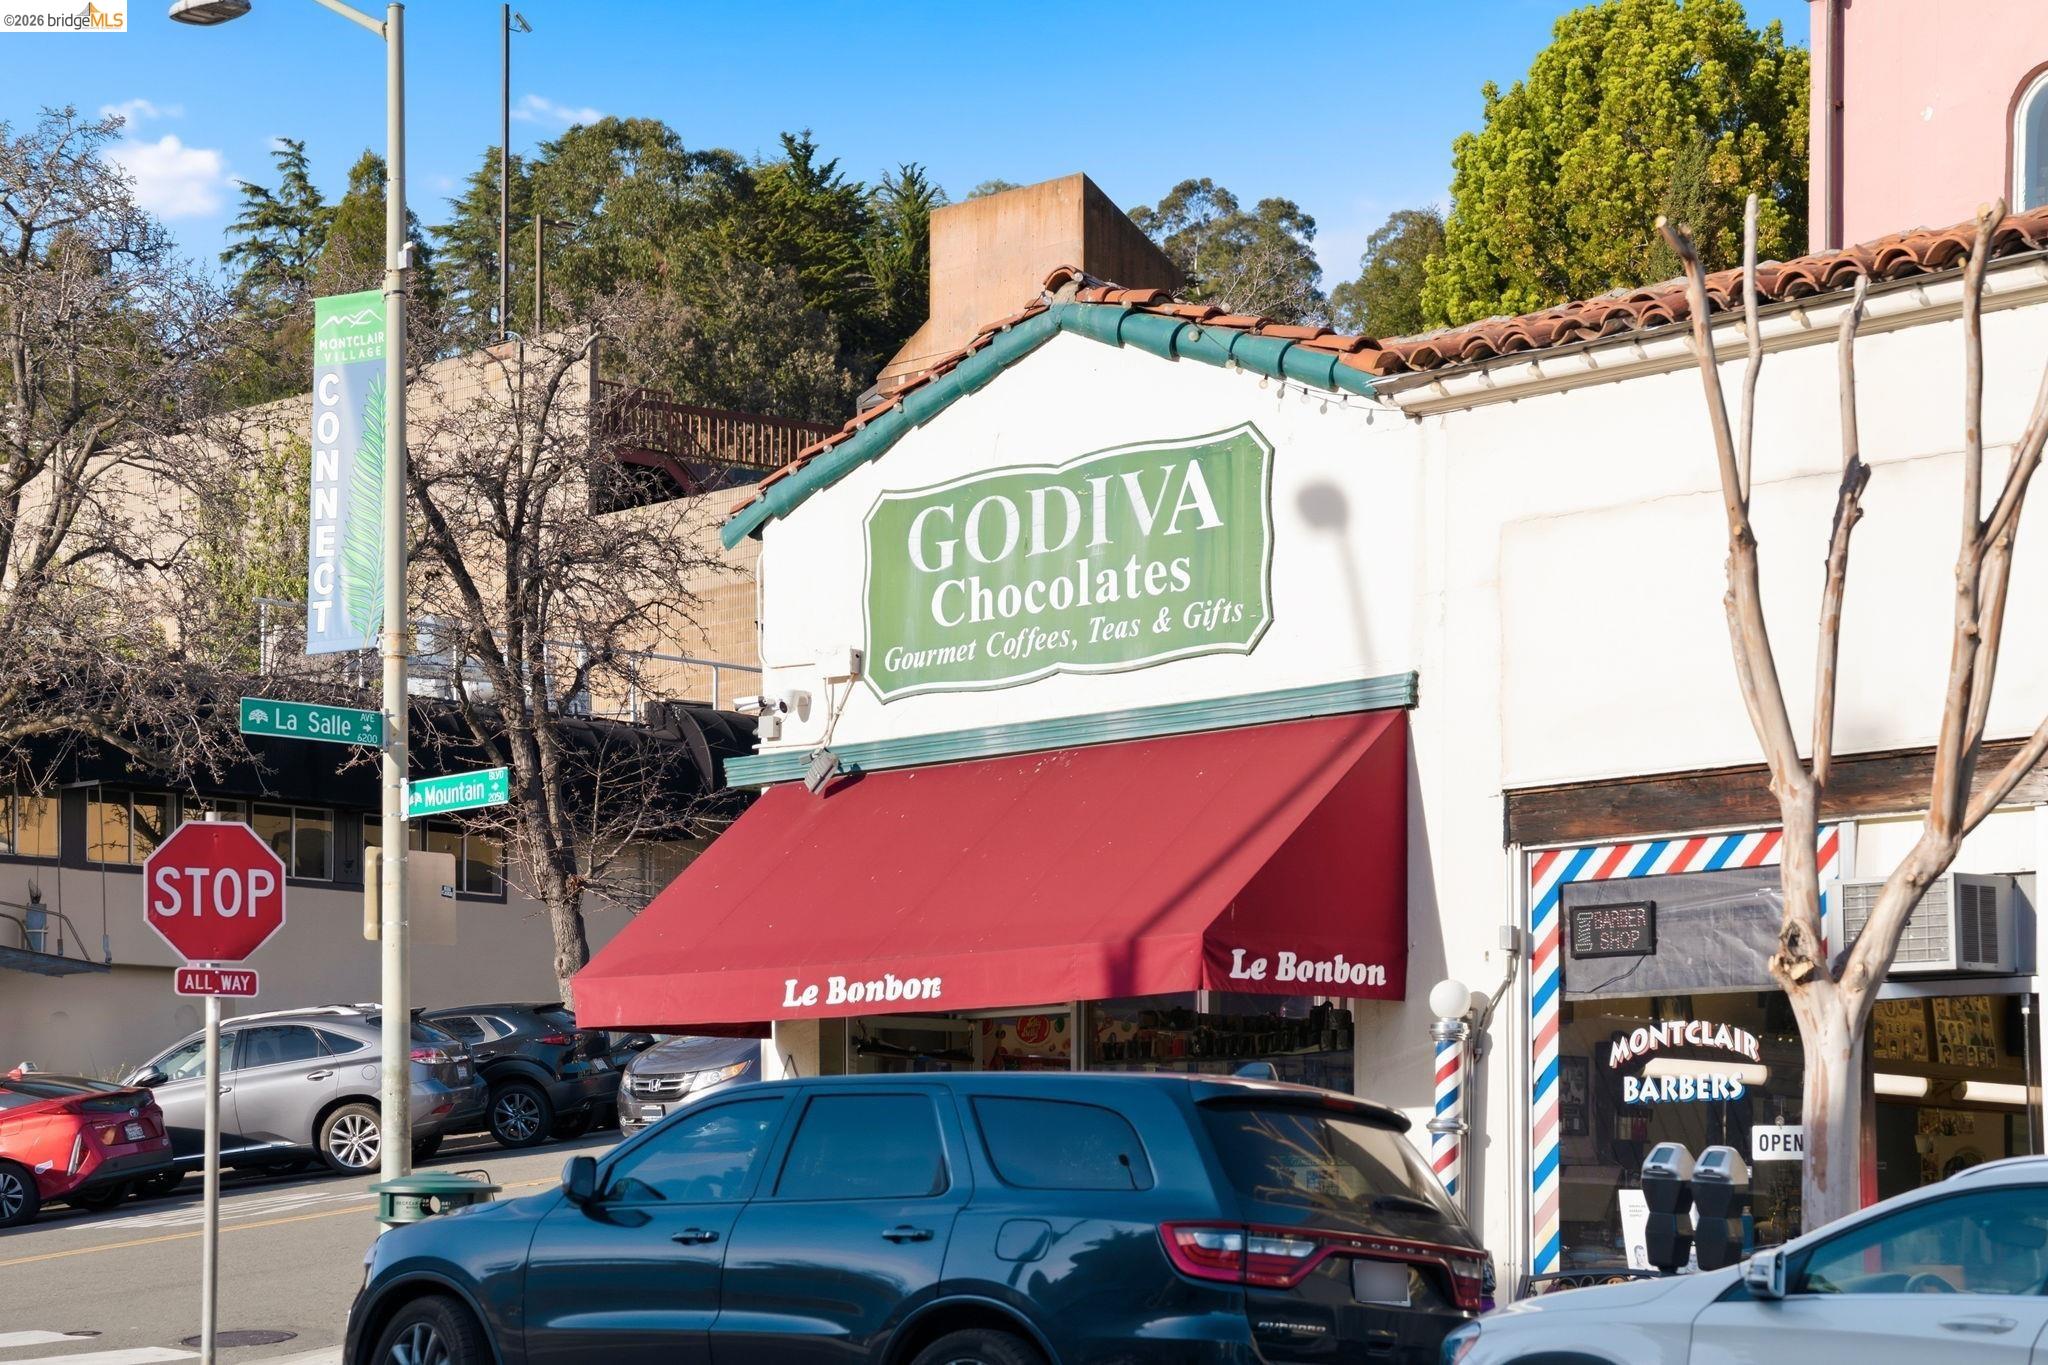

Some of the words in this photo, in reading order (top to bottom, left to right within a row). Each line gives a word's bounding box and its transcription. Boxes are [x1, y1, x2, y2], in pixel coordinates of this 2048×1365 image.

[320, 332, 385, 351] MONTCLAIR
[324, 346, 382, 362] VILLAGE
[313, 373, 340, 633] CONNECT
[907, 459, 1224, 573] GODIVA
[931, 554, 1191, 627] Chocolates
[884, 639, 977, 672] Gourmet
[986, 626, 1078, 660] Coffees,
[1088, 616, 1140, 644] Teas
[1152, 606, 1172, 633] &
[1183, 598, 1244, 632] Gifts
[275, 707, 297, 731] La
[308, 711, 351, 736] Salle
[360, 713, 375, 723] AVE
[357, 734, 377, 743] 6200
[488, 770, 504, 780] BLVD
[424, 779, 484, 807] Mountain
[154, 866, 275, 918] STOP
[1594, 908, 1646, 929] BARBER
[1600, 930, 1640, 950] SHOP
[1229, 948, 1268, 980] Le
[1275, 951, 1387, 986] Bonbon
[184, 974, 213, 990] ALL
[221, 975, 250, 991] WAY
[782, 979, 819, 1007] Le
[825, 973, 942, 1005] Bonbon
[1609, 1020, 1761, 1069] MONTCLAIR
[1623, 1071, 1746, 1105] BARBERS
[1759, 1133, 1804, 1152] OPEN
